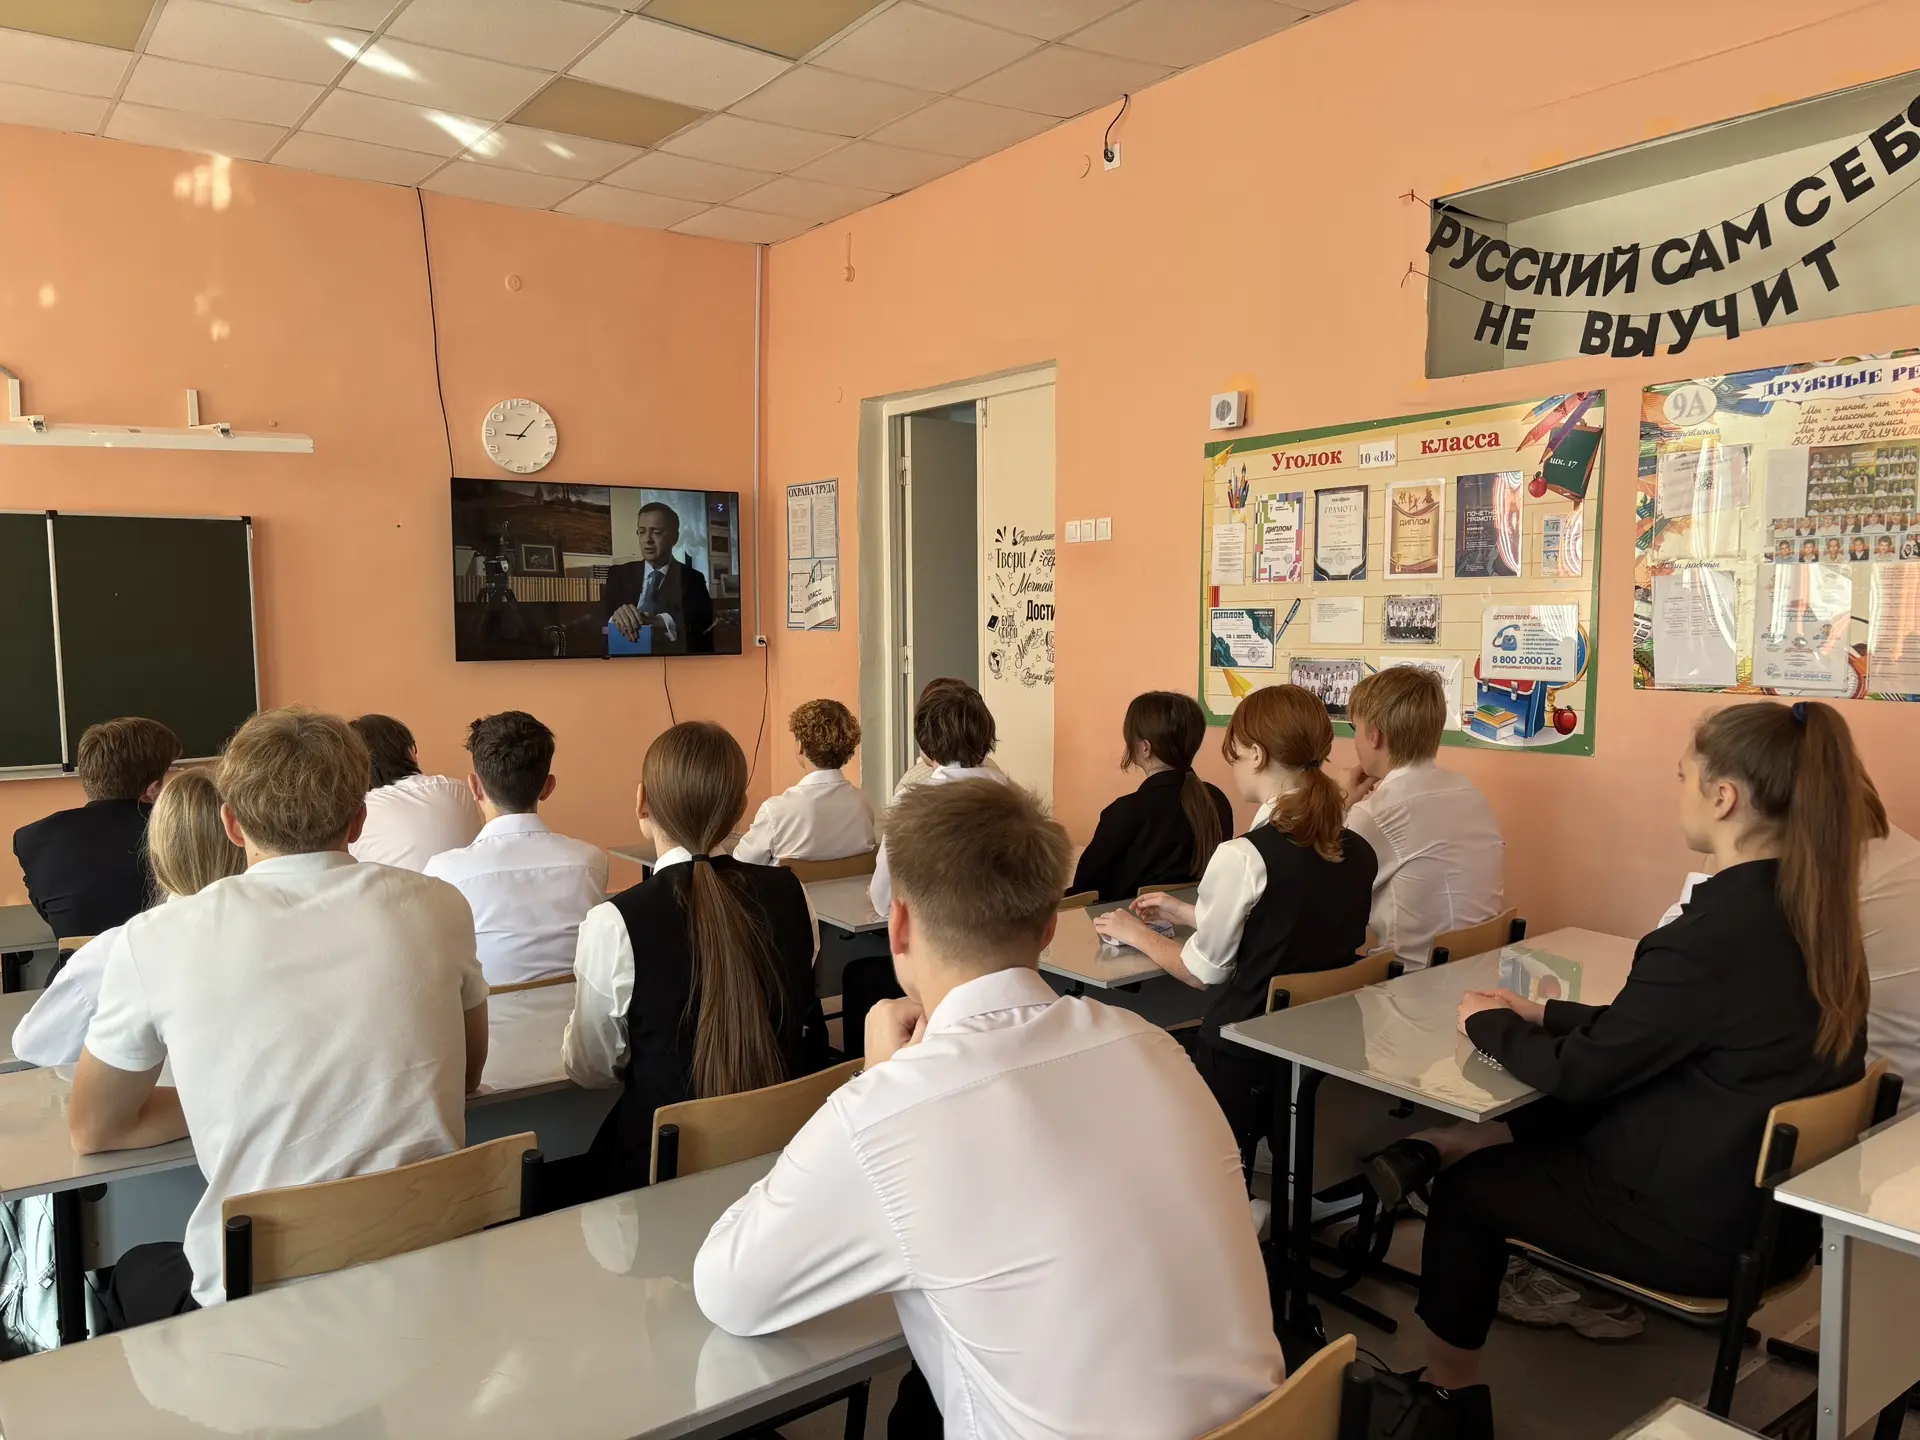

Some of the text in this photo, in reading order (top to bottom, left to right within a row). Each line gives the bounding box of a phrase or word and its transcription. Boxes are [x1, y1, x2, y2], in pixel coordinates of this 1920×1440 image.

[1425, 214, 1641, 297] РУССКИЙ
[1651, 203, 1772, 286] САМ
[1474, 240, 1840, 358] НЕ ВЫУЧИТ
[1761, 369, 1883, 399] ДРУЖНЫЕ
[1672, 388, 1708, 420] 9А
[1831, 411, 1878, 422] классные,
[1818, 421, 1864, 436] прилежно
[1868, 418, 1907, 430] учимся.
[1829, 431, 1854, 443] НАС
[1854, 424, 1920, 442] ПОЛУЧИТ
[1272, 431, 1501, 472] Уголок 10 «И» класса
[1567, 460, 1578, 469] 17
[788, 483, 835, 497] ОХРАНА ТРУДА
[1324, 504, 1357, 514] ГРАМОТА
[1467, 509, 1498, 517] ПОЧЕТНА
[1399, 518, 1430, 527] ДИПЛОМ
[1265, 525, 1292, 534] ДИПЛОМ
[1213, 611, 1244, 620] ДИПЛОМ
[1492, 655, 1562, 665] 8 800 2000 122
